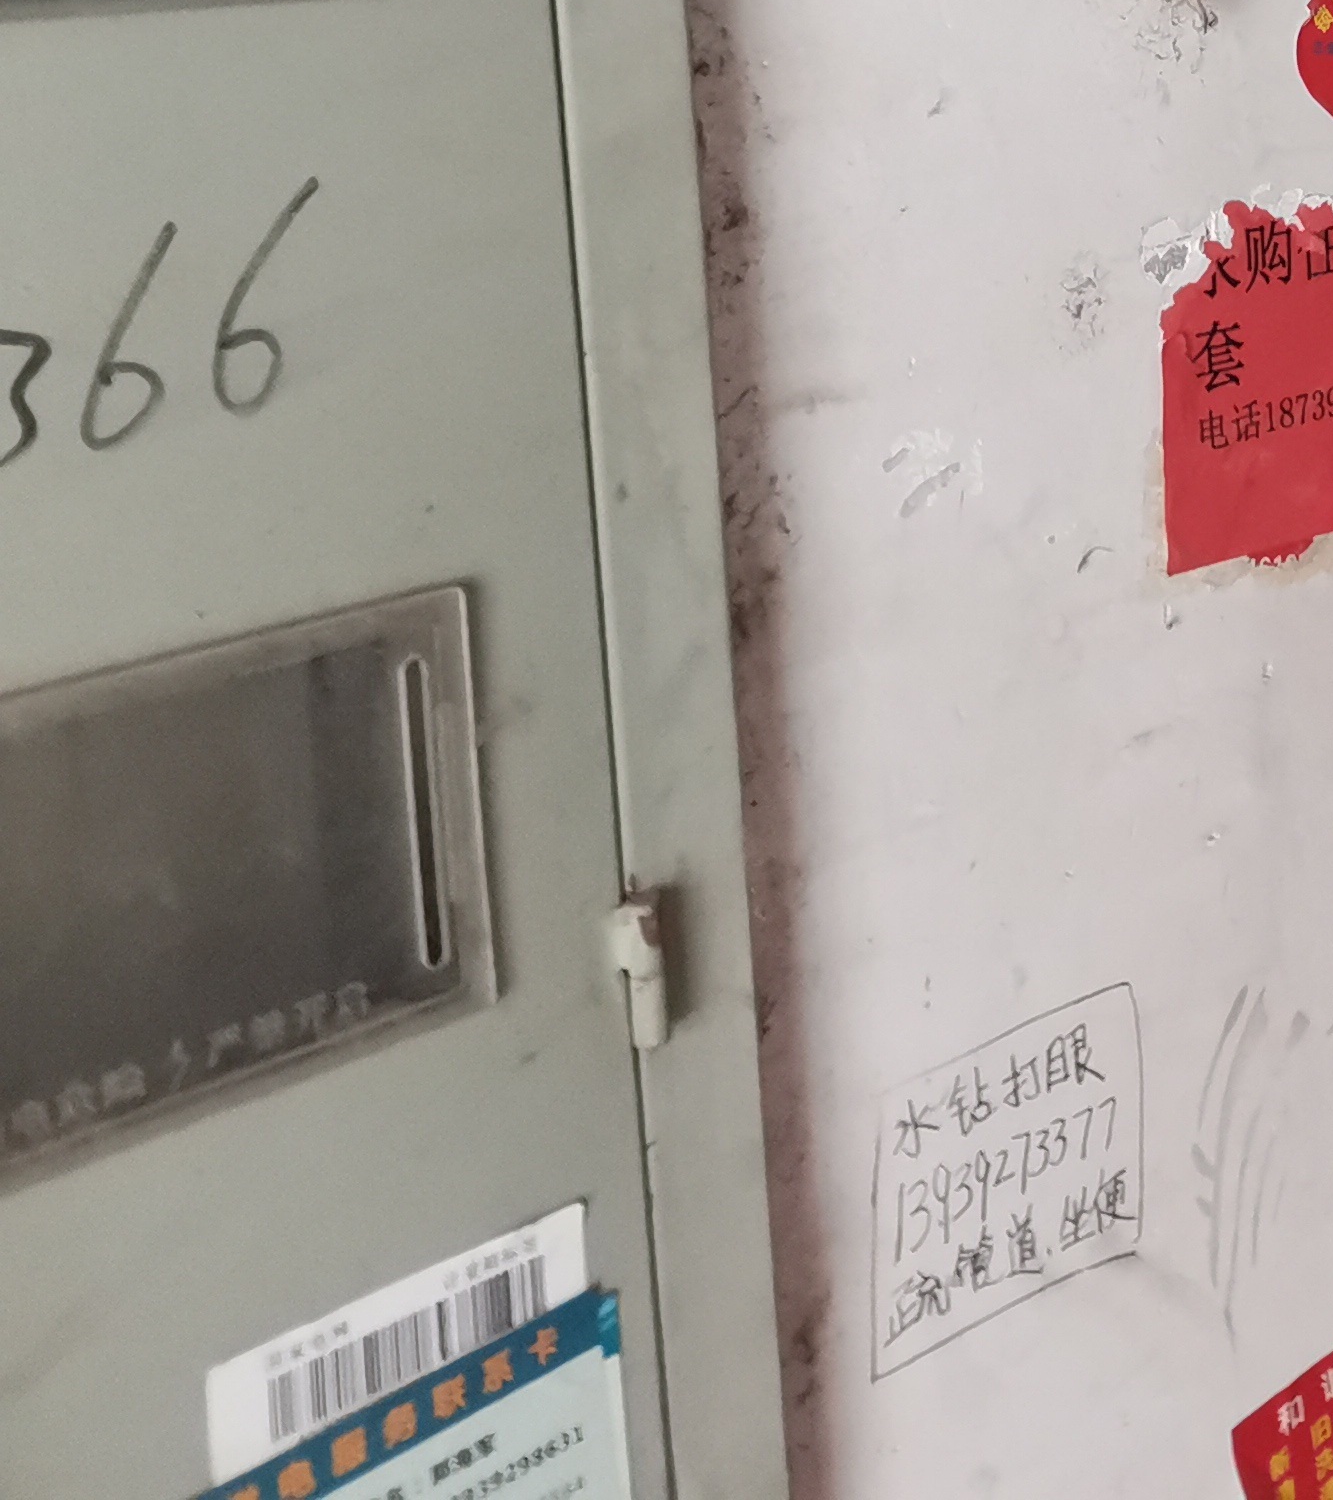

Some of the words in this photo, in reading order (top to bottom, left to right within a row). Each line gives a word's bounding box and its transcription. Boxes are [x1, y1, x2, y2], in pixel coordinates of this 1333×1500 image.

[1194, 318, 1245, 393] 套
[893, 1022, 1106, 1158] 水钻打眼
[894, 1095, 1118, 1267] 13939273377
